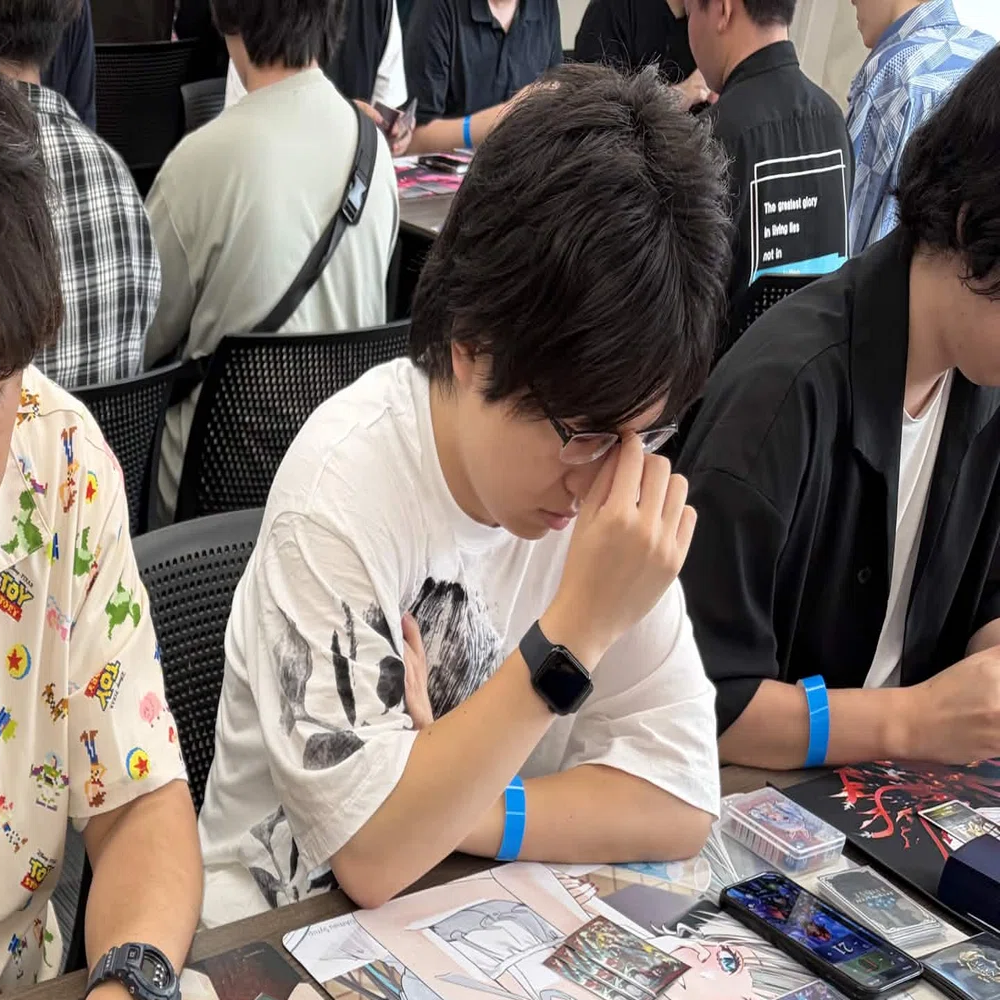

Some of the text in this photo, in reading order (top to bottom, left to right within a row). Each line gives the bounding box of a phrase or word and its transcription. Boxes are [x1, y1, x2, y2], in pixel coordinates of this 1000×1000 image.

[764, 196, 818, 214] The greatest glory
[764, 221, 800, 238] in living lies
[763, 248, 782, 261] not in
[0, 571, 34, 607] TOY
[96, 660, 121, 711] TOY
